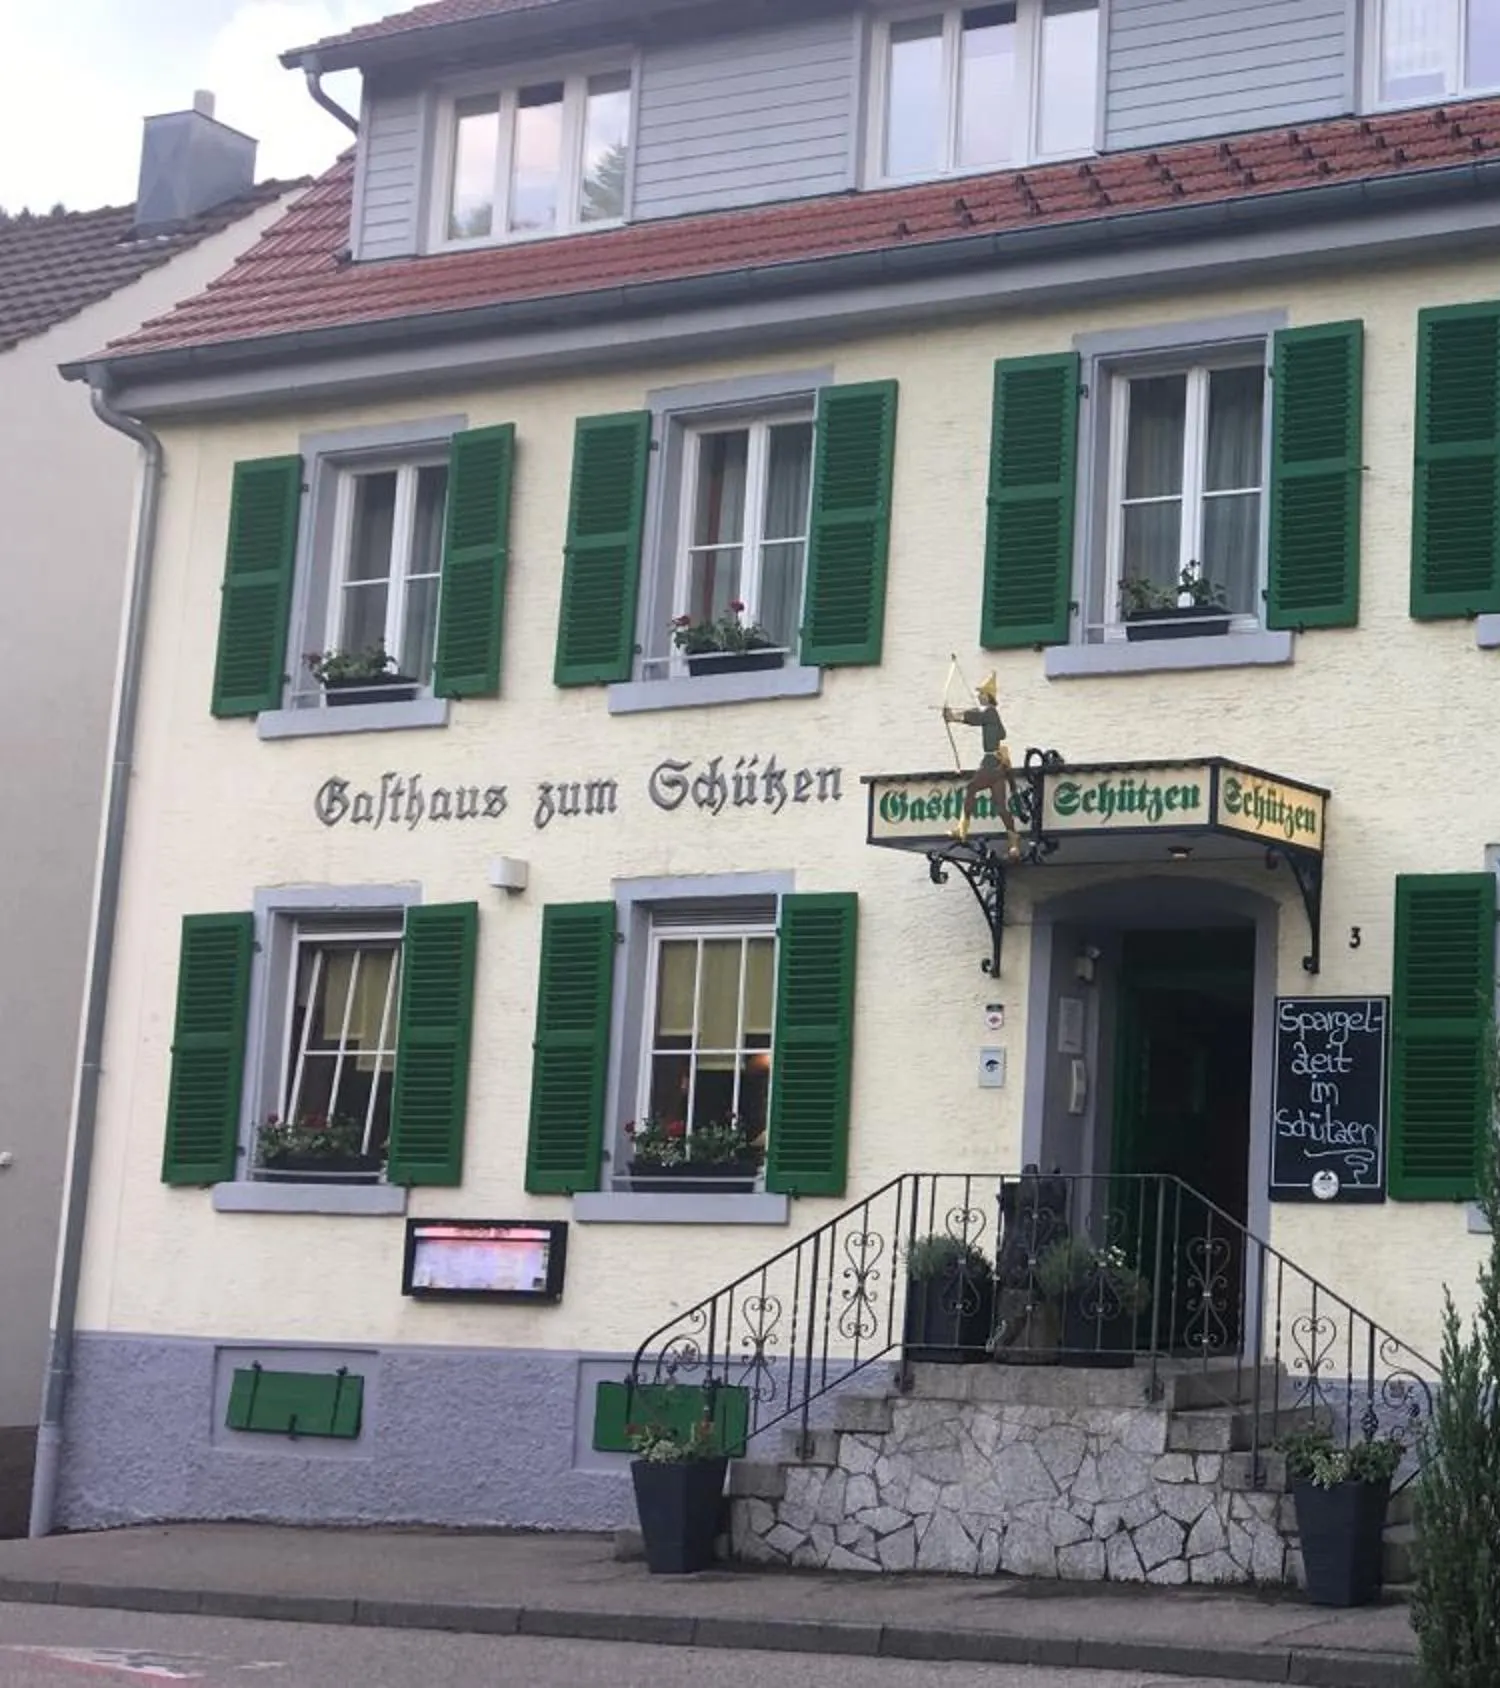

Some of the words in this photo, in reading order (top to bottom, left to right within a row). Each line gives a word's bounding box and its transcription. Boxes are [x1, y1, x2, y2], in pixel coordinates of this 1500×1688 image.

[533, 776, 619, 830] zum
[648, 753, 843, 817] Schützen
[879, 786, 1025, 824] Gastas
[1053, 778, 1202, 824] Schützen
[1223, 776, 1317, 838] Schützen
[1349, 926, 1361, 949] 3
[1310, 1073, 1339, 1105] im
[1276, 1103, 1379, 1145] Schützen
